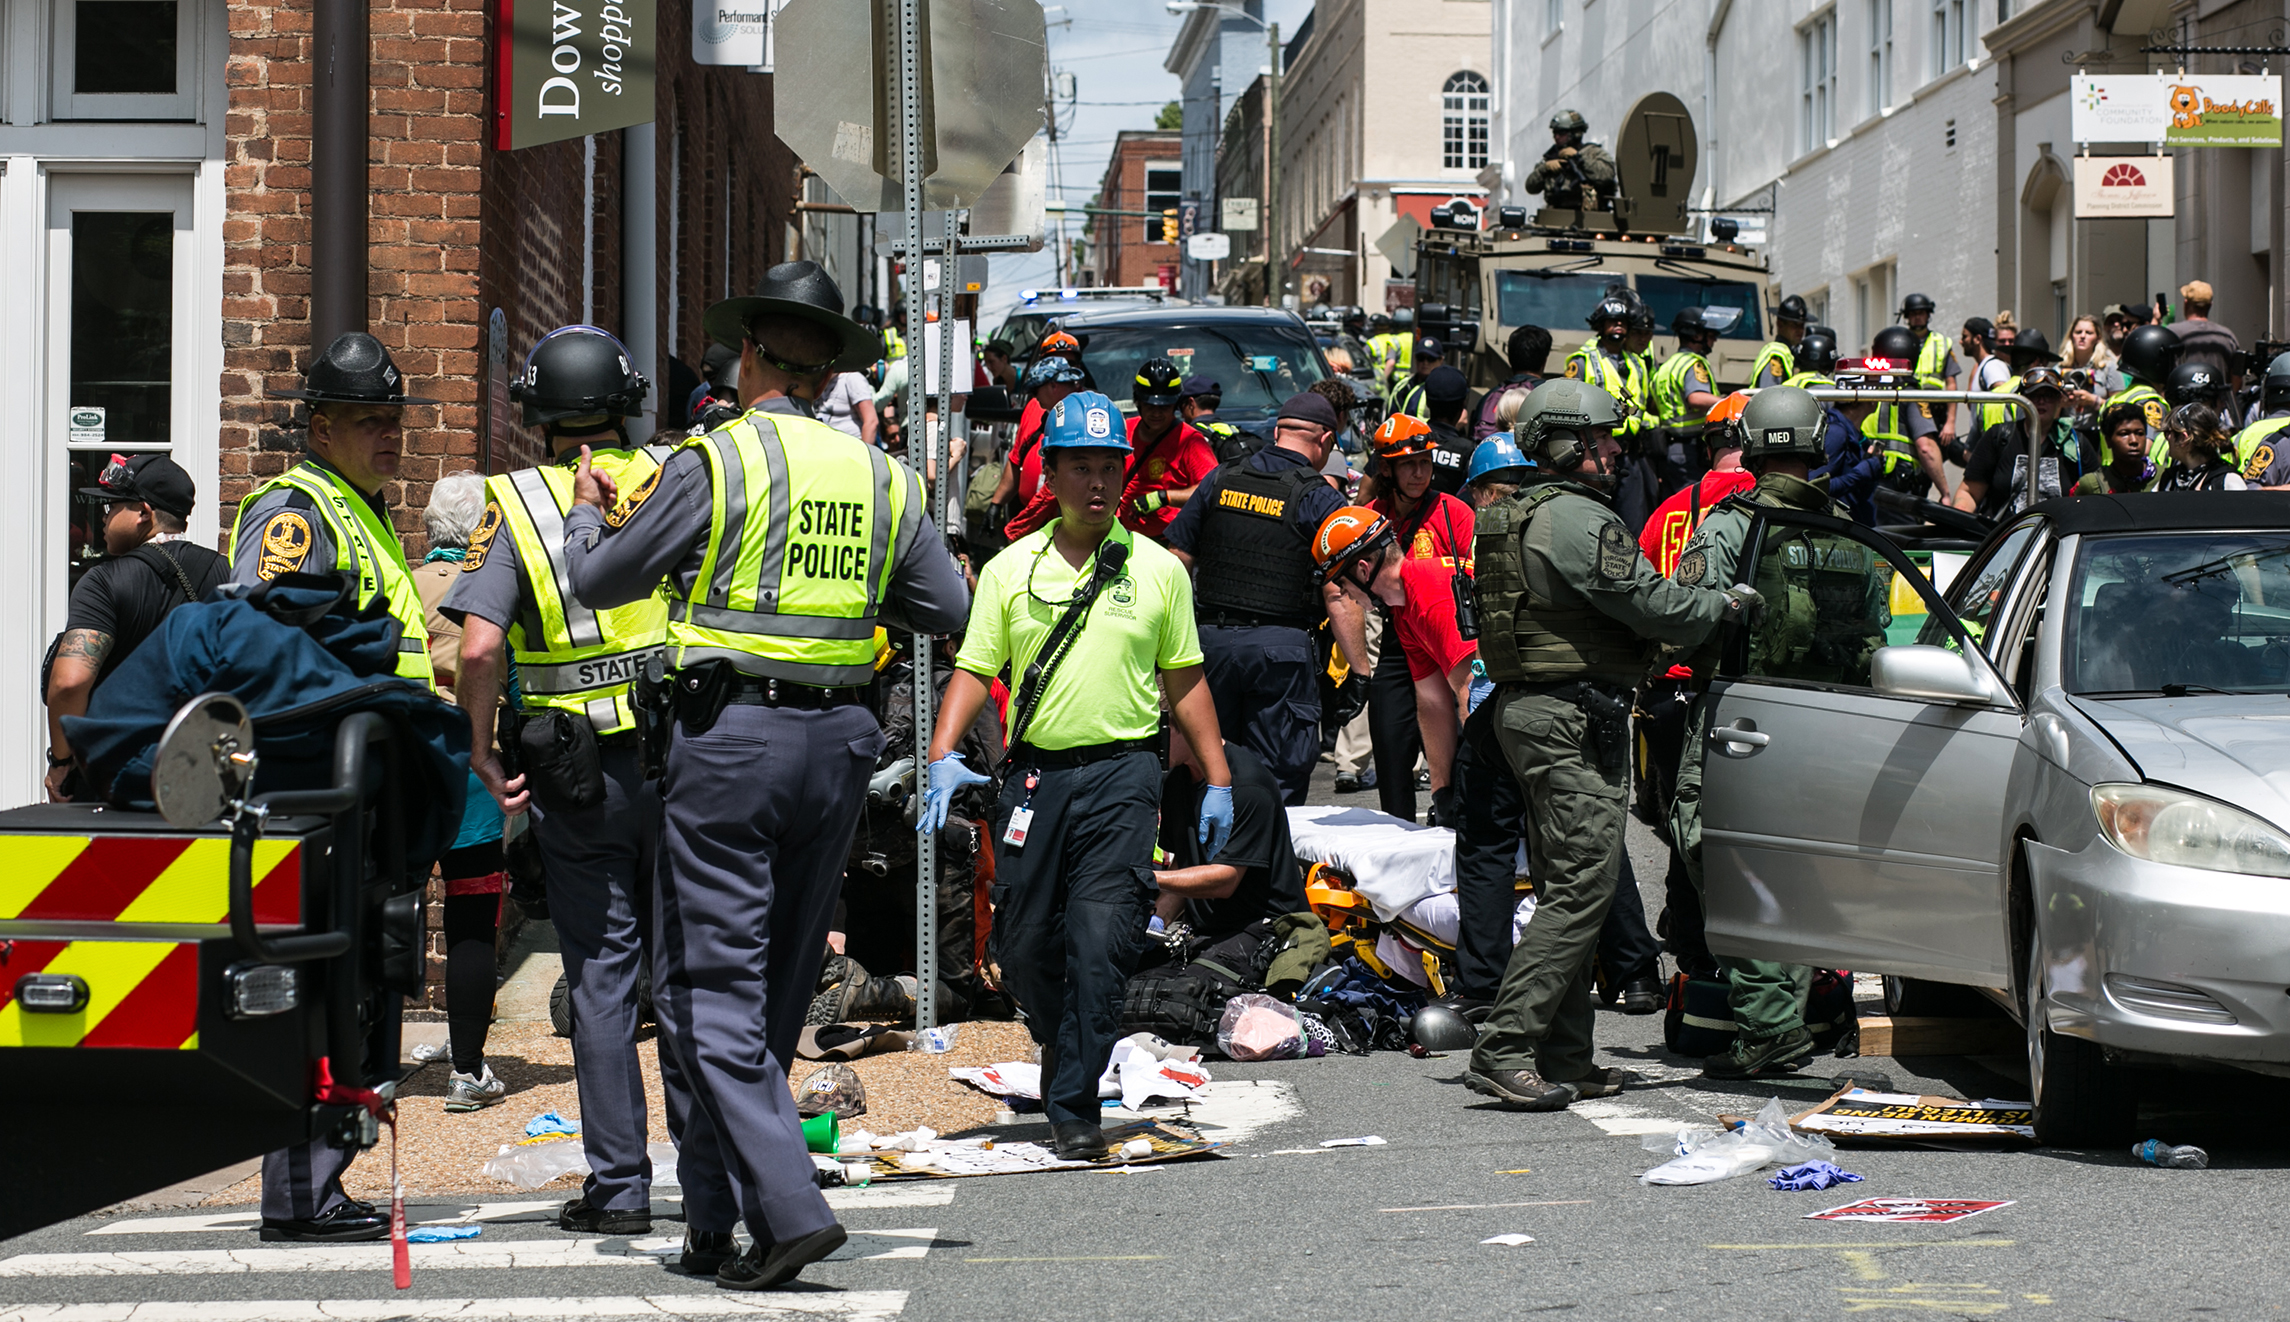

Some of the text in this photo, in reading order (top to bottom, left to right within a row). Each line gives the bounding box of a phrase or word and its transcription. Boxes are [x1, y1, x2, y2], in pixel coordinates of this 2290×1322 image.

[2096, 108, 2153, 117] COMMUNITY
[2203, 96, 2275, 118] DoodyCalls
[2100, 116, 2163, 125] FOUNDATION
[2191, 372, 2211, 384] 454
[1768, 431, 1790, 444] MED
[1432, 449, 1462, 468] ICE
[1219, 488, 1286, 517] STATE POLICE
[800, 499, 864, 538] STATE
[263, 554, 297, 571] VIRGINIA
[787, 543, 868, 581] POLICE
[1603, 555, 1632, 568] VIRGINIA
[1787, 545, 1824, 567] STTE
[1602, 567, 1628, 577] POLICE
[1604, 561, 1627, 572] STATE
[1104, 610, 1137, 621] SUPERVISOR
[1108, 606, 1133, 614] RESCUE
[578, 653, 647, 685] STATE
[1832, 1107, 1912, 1120] BEING
[2001, 1110, 2028, 1120] IS
